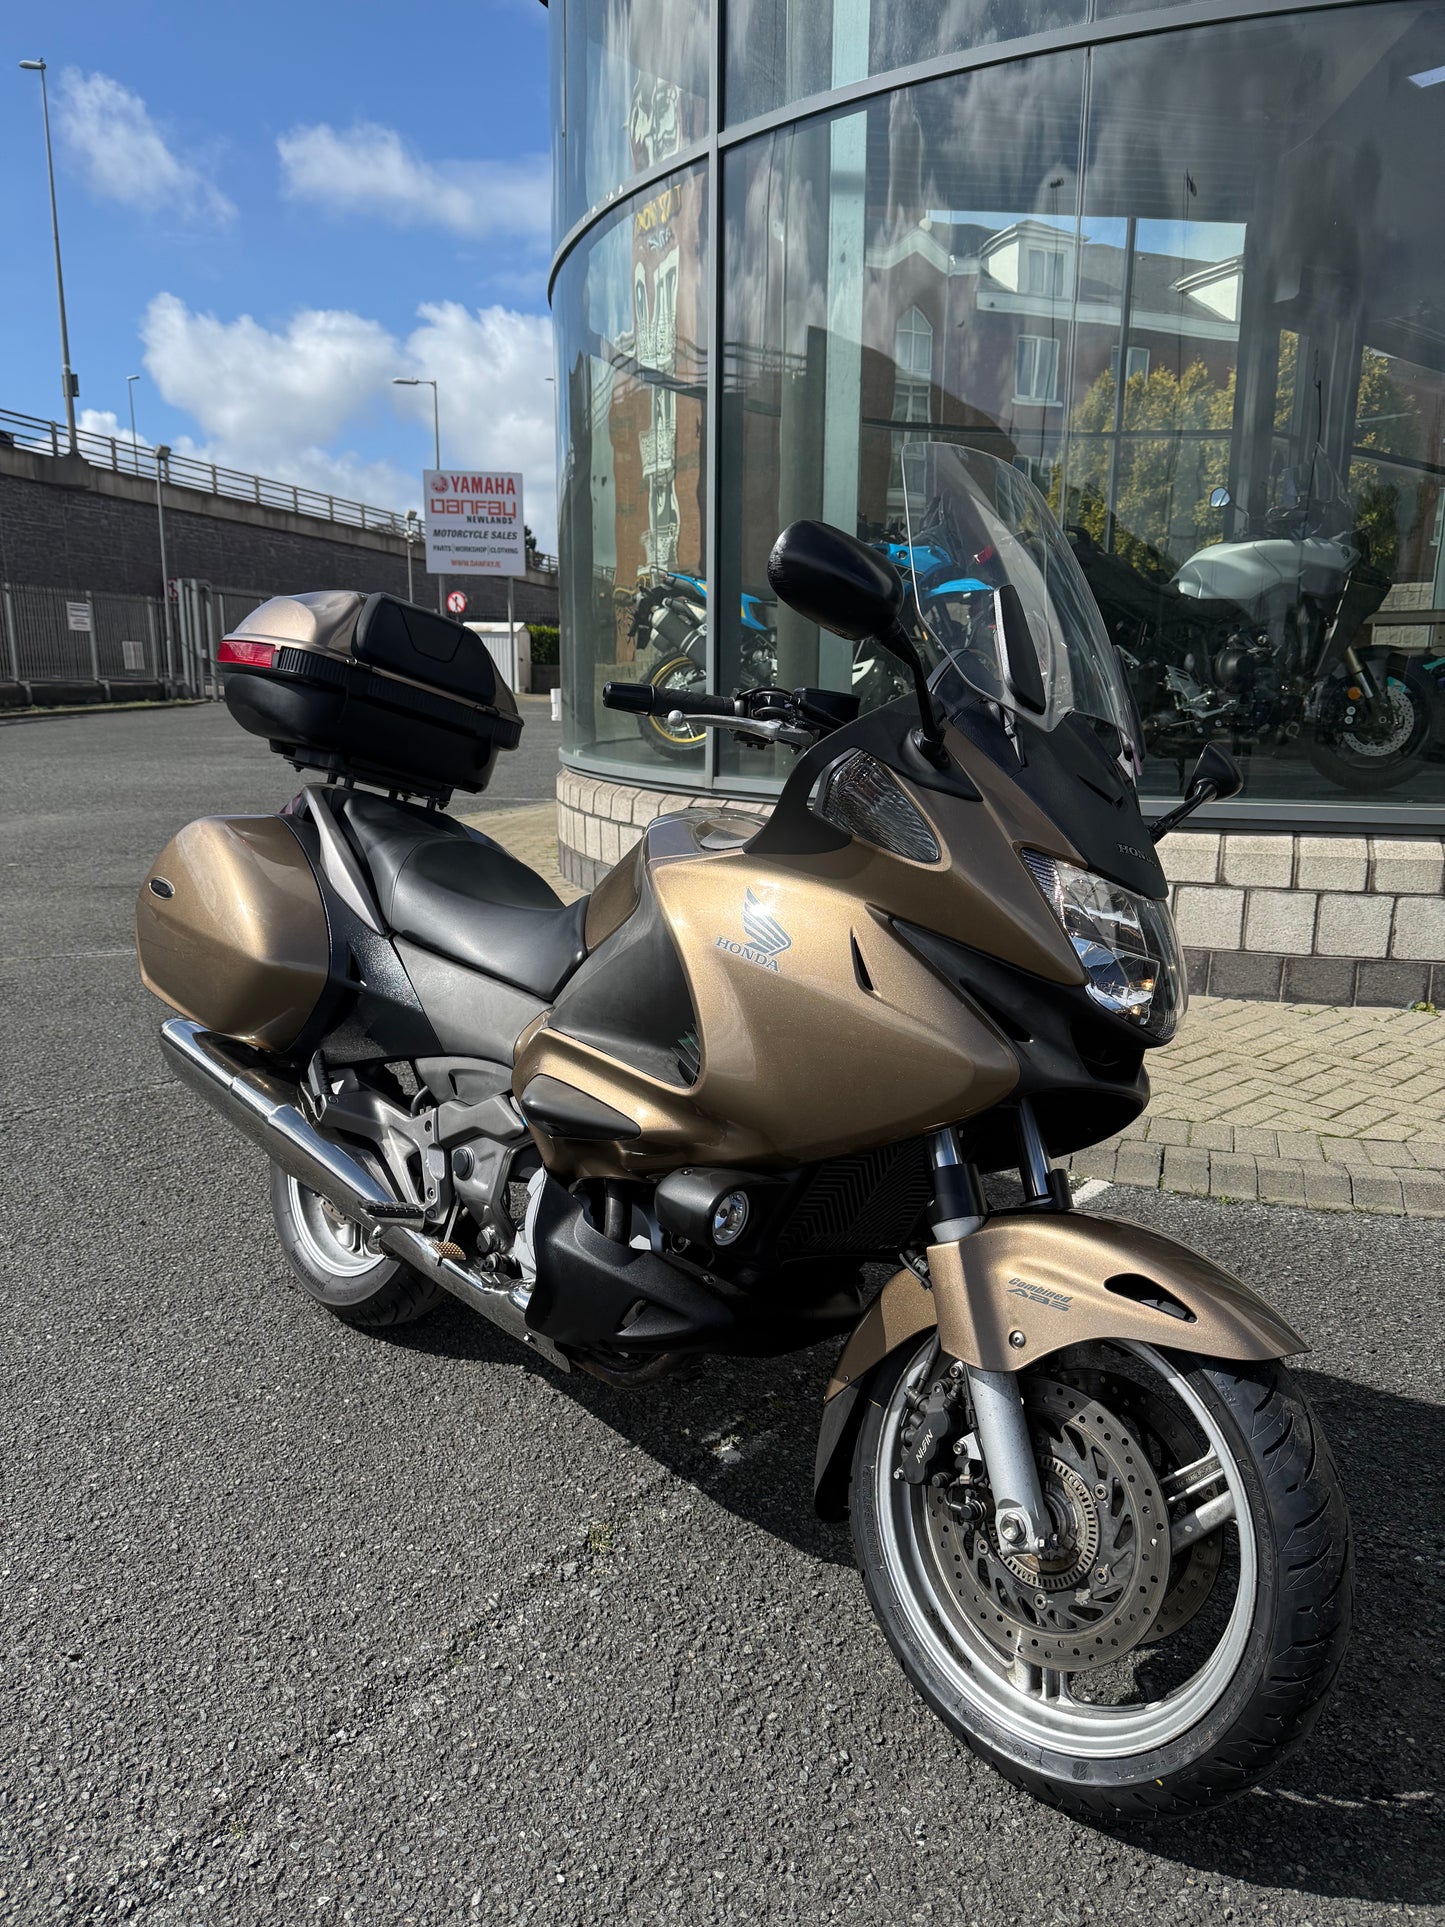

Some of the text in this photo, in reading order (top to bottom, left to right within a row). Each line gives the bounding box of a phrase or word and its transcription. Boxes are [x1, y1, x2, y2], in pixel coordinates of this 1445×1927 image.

[450, 475, 516, 495] YAMAHA
[466, 516, 513, 525] NEWLANDS
[433, 529, 518, 540] MOTORCYCLE SALES
[715, 936, 780, 972] HONDA
[1006, 1288, 1072, 1312] ABS
[1008, 1277, 1074, 1303] Combined
